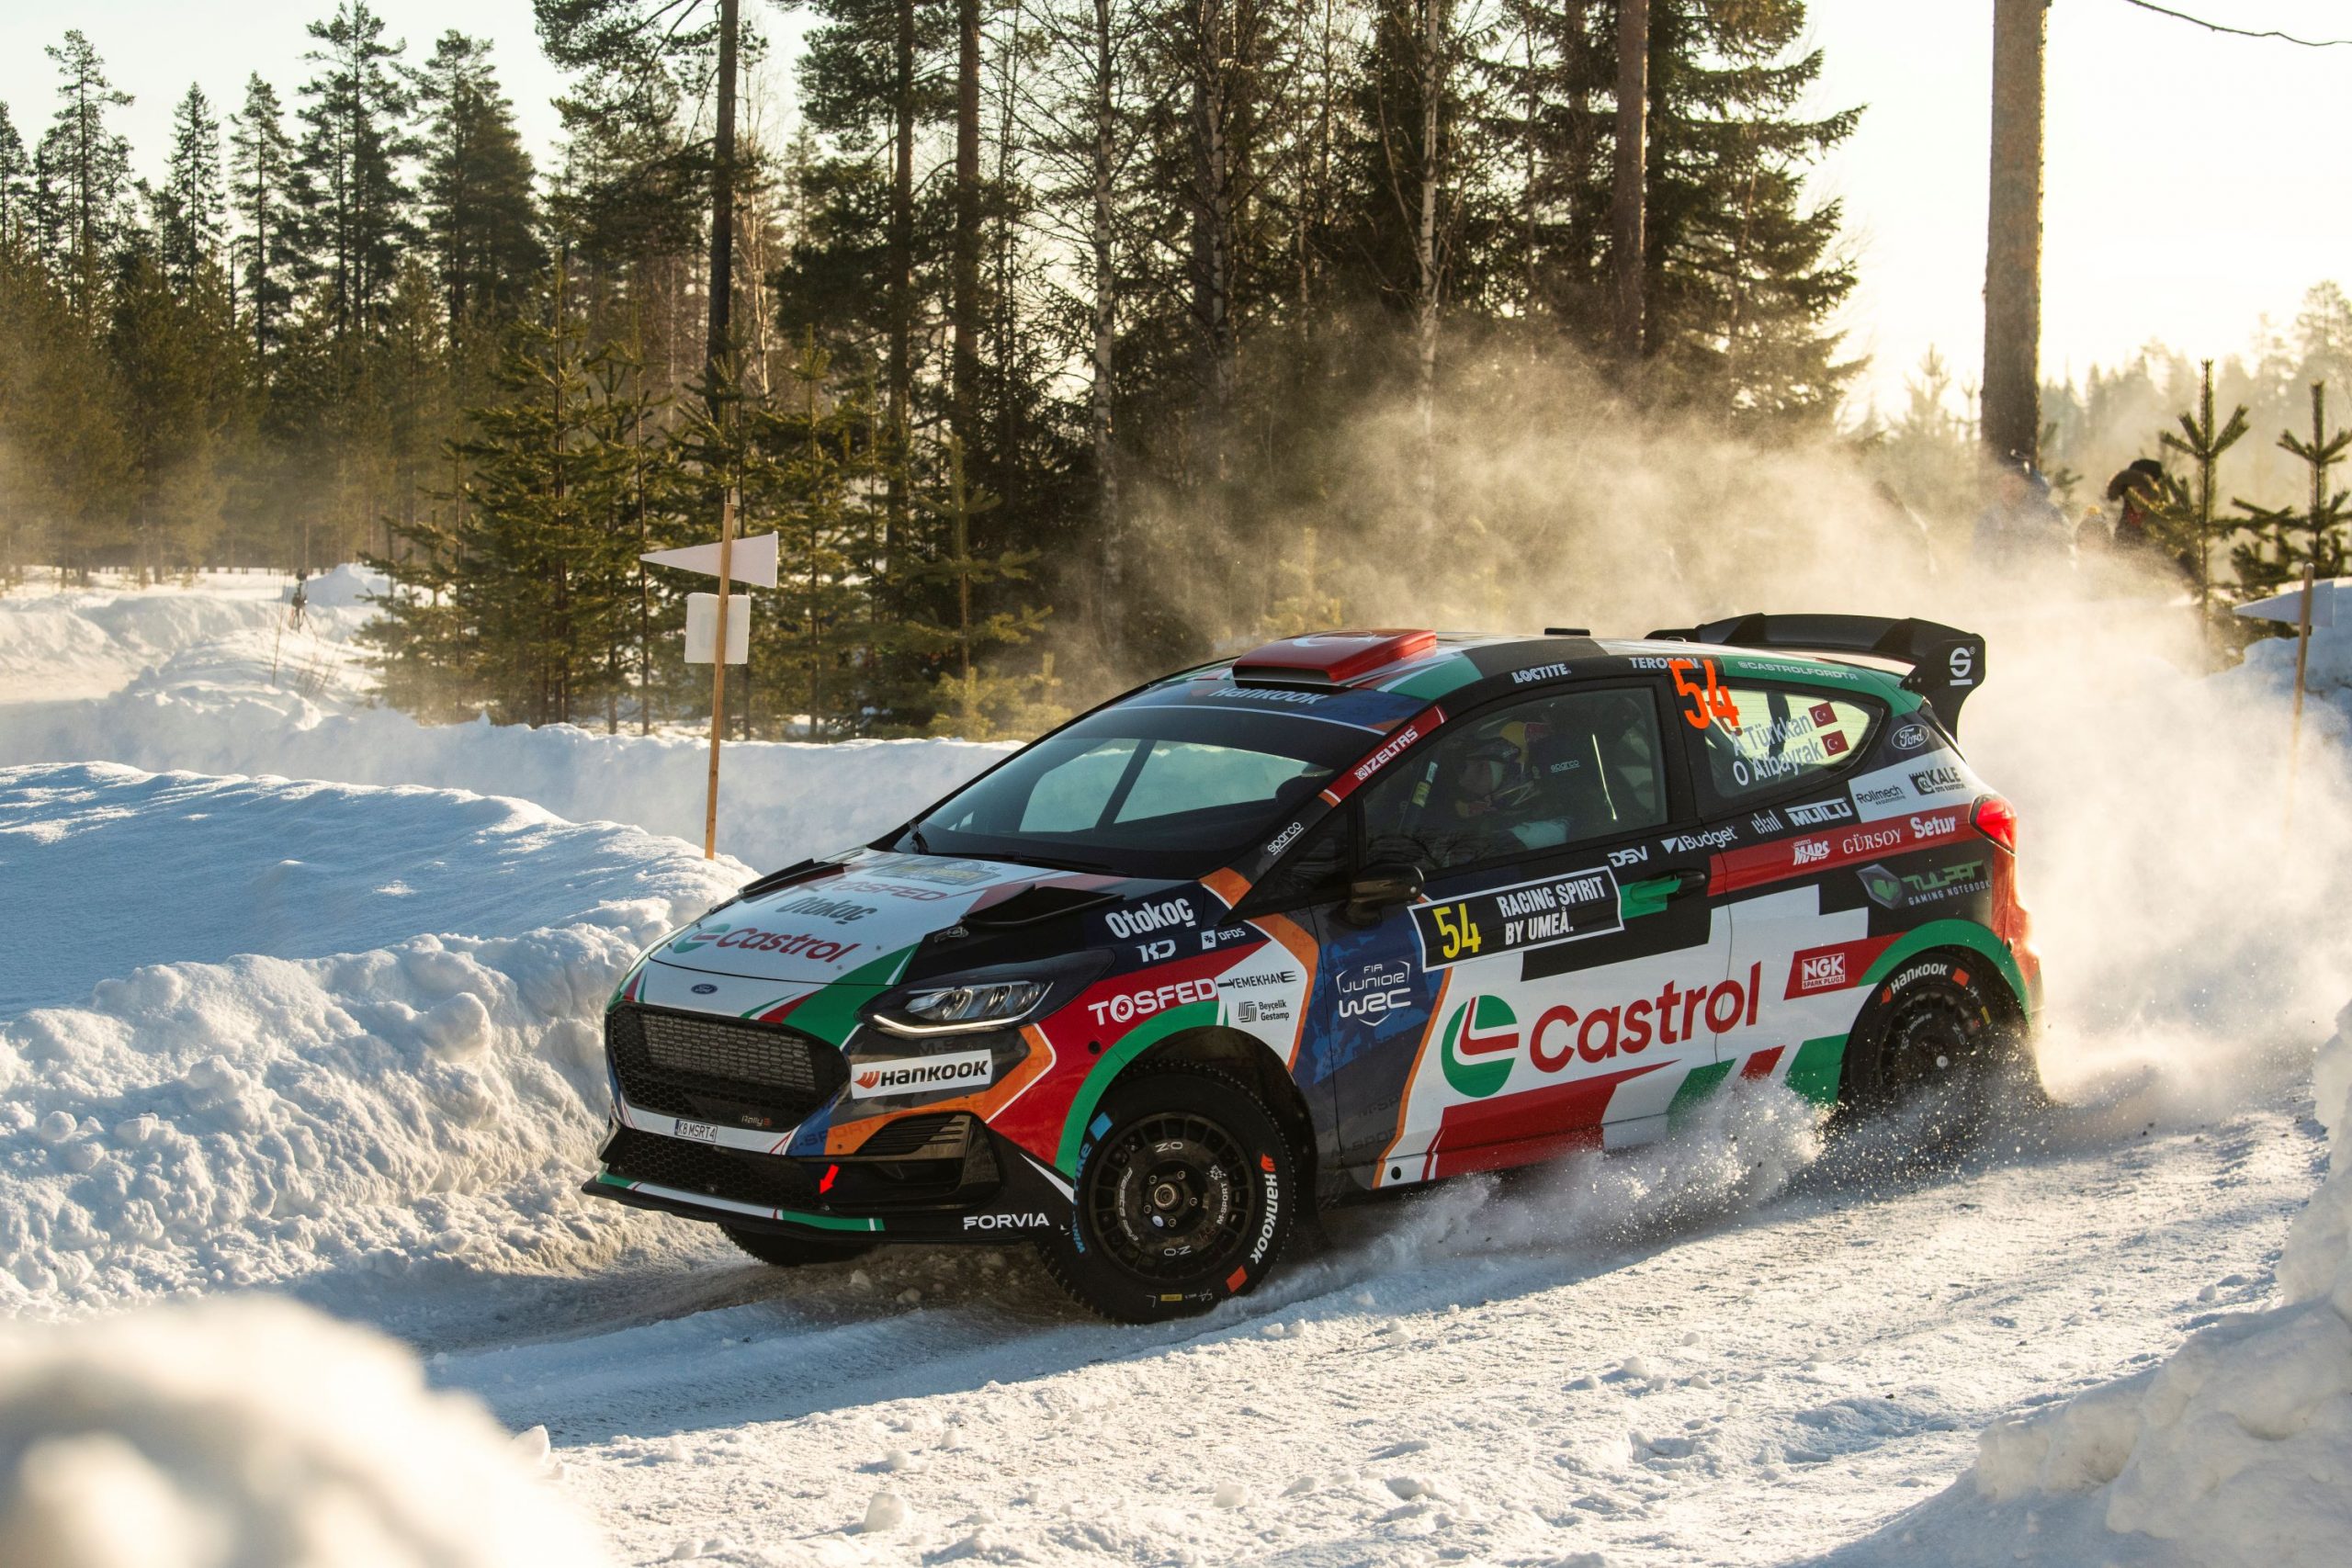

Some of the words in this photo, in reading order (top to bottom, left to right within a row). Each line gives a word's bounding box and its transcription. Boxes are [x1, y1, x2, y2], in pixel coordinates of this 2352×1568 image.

[1511, 663, 1568, 683] LOCTITE
[1738, 661, 1859, 680] @CASTROLFORDTR
[1669, 660, 1740, 728] 54
[1731, 732, 1743, 756] A
[1744, 714, 1813, 750] Türkkan
[1899, 728, 1924, 748] Ford
[1733, 761, 1748, 785] O
[1753, 738, 1824, 782] Albayrak
[1926, 767, 1962, 788] KALE
[1856, 784, 1904, 804] Rollmech
[1268, 821, 1304, 855] sparco
[1682, 827, 1738, 851] Budget
[1910, 816, 1956, 839] Setur
[1792, 840, 1831, 866] MARS
[1842, 829, 1902, 854] GÜRSOY
[1608, 845, 1648, 867] DSV
[1497, 892, 1556, 918] RACING
[1555, 876, 1606, 905] SPIRIT
[1908, 889, 1944, 906] GAMING
[1947, 879, 1992, 897] NOTEBOOK
[1105, 898, 1196, 939] Otokoç
[1432, 903, 1481, 959] 54
[1217, 928, 1246, 941] DFDS
[1505, 920, 1524, 945] BY
[717, 928, 861, 963] Castrol
[1363, 964, 1383, 974] FIA
[1804, 954, 1844, 980] NGK
[1229, 971, 1298, 989] YEMEKHANE
[1342, 973, 1405, 993] JUNIOR
[1088, 977, 1218, 1026] TOSFED
[1259, 999, 1287, 1011] Beyçelik
[1339, 987, 1411, 1018] WRC
[1261, 1011, 1289, 1021] Gestamp
[1530, 961, 1761, 1073] Castrol
[679, 1121, 687, 1135] K8
[689, 1123, 716, 1140] MSRT4
[1216, 1182, 1228, 1224] M-SPORT
[963, 1213, 1049, 1230] FORVIA
